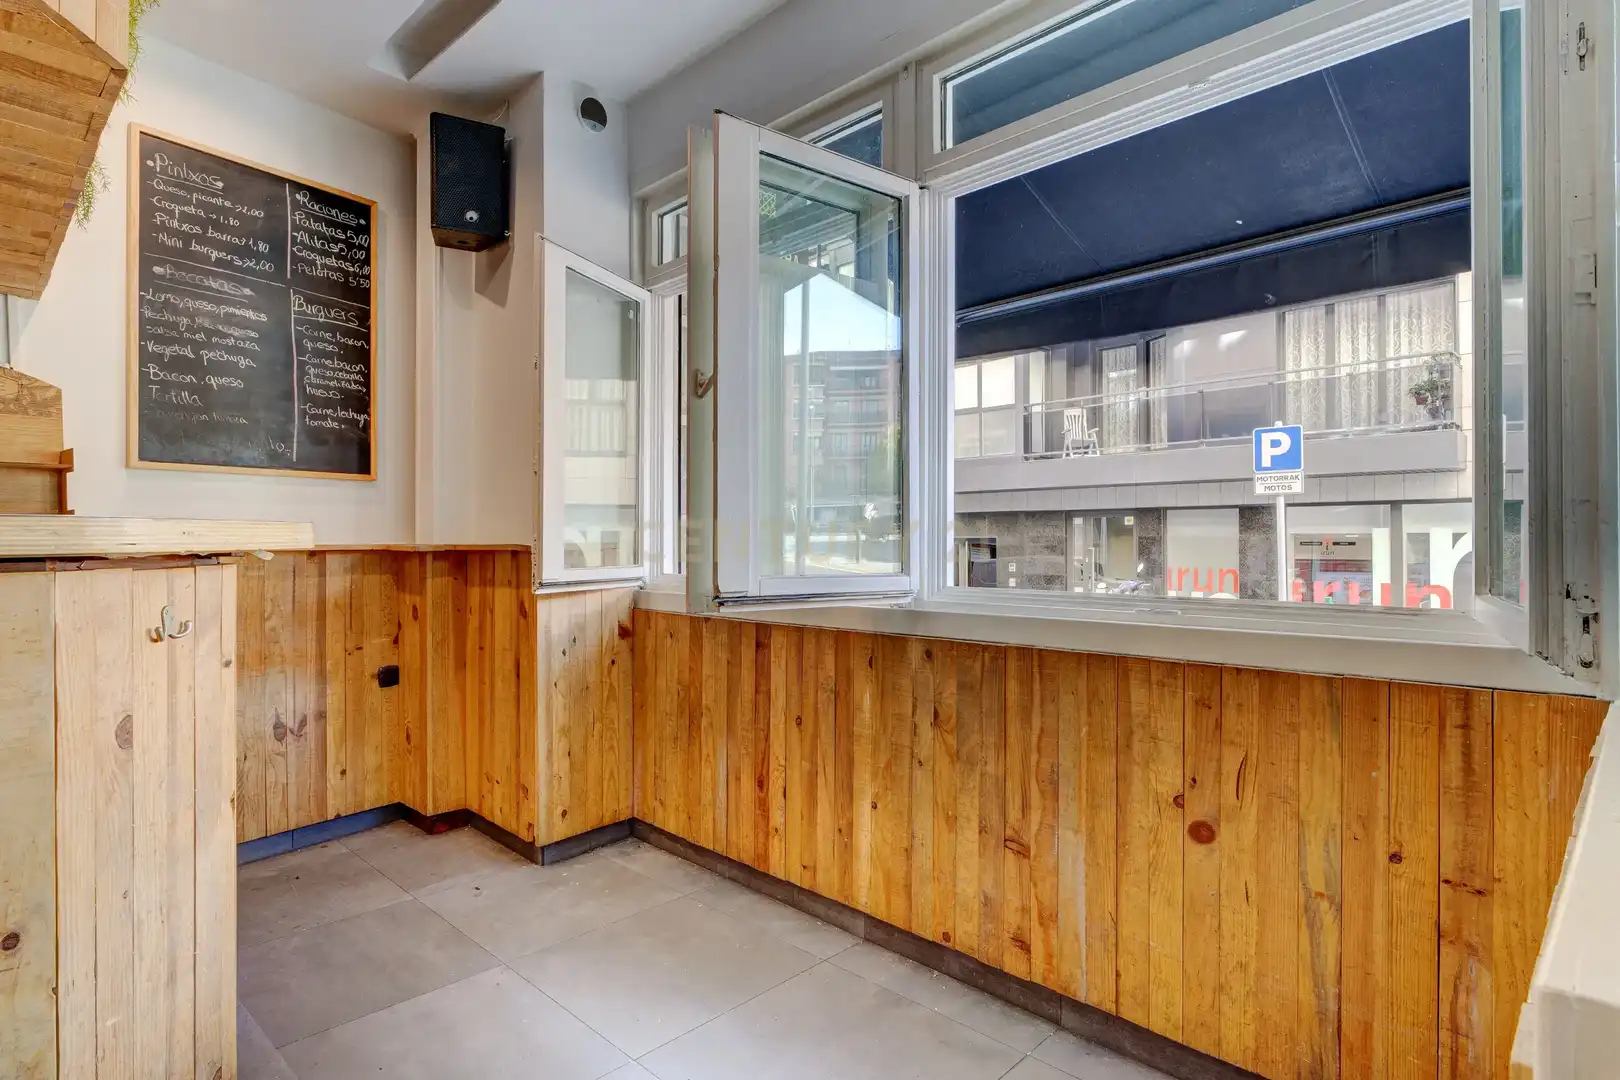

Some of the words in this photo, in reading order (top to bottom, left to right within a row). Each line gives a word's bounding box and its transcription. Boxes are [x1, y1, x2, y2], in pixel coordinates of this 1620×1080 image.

[192, 192, 233, 208] picante
[299, 190, 358, 224] Raciones
[293, 294, 359, 327] Burguers
[211, 336, 261, 351] mostaza
[205, 375, 244, 390] queso
[1261, 431, 1292, 468] P
[1256, 474, 1301, 483] MOTORRAK
[1264, 484, 1293, 492] MOTOS
